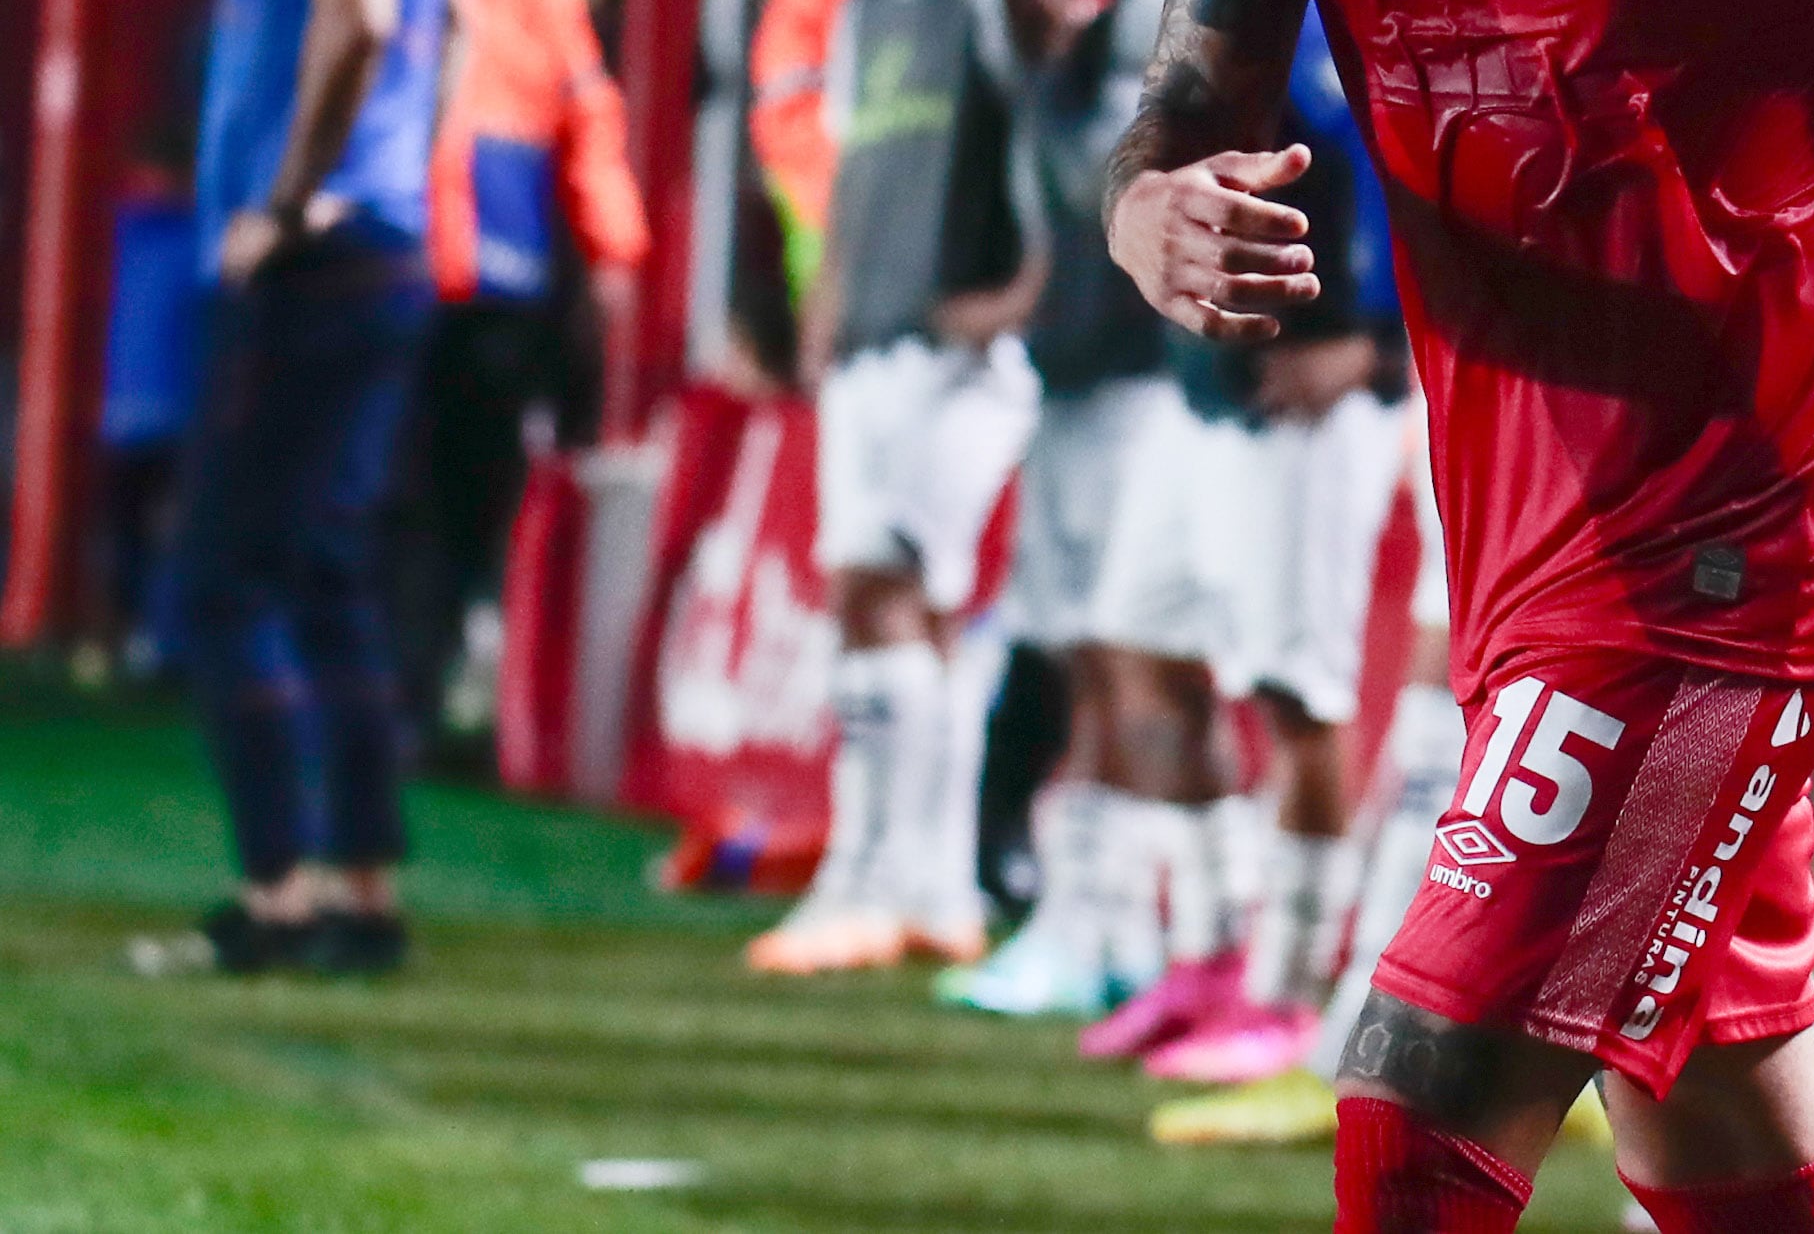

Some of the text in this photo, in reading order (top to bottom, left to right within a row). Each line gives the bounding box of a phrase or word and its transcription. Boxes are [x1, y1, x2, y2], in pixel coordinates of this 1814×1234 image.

[1461, 675, 1627, 846] 15
[1428, 862, 1493, 900] umbro
[1618, 764, 1778, 1041] andina
[1633, 865, 1701, 985] PINTURAS
